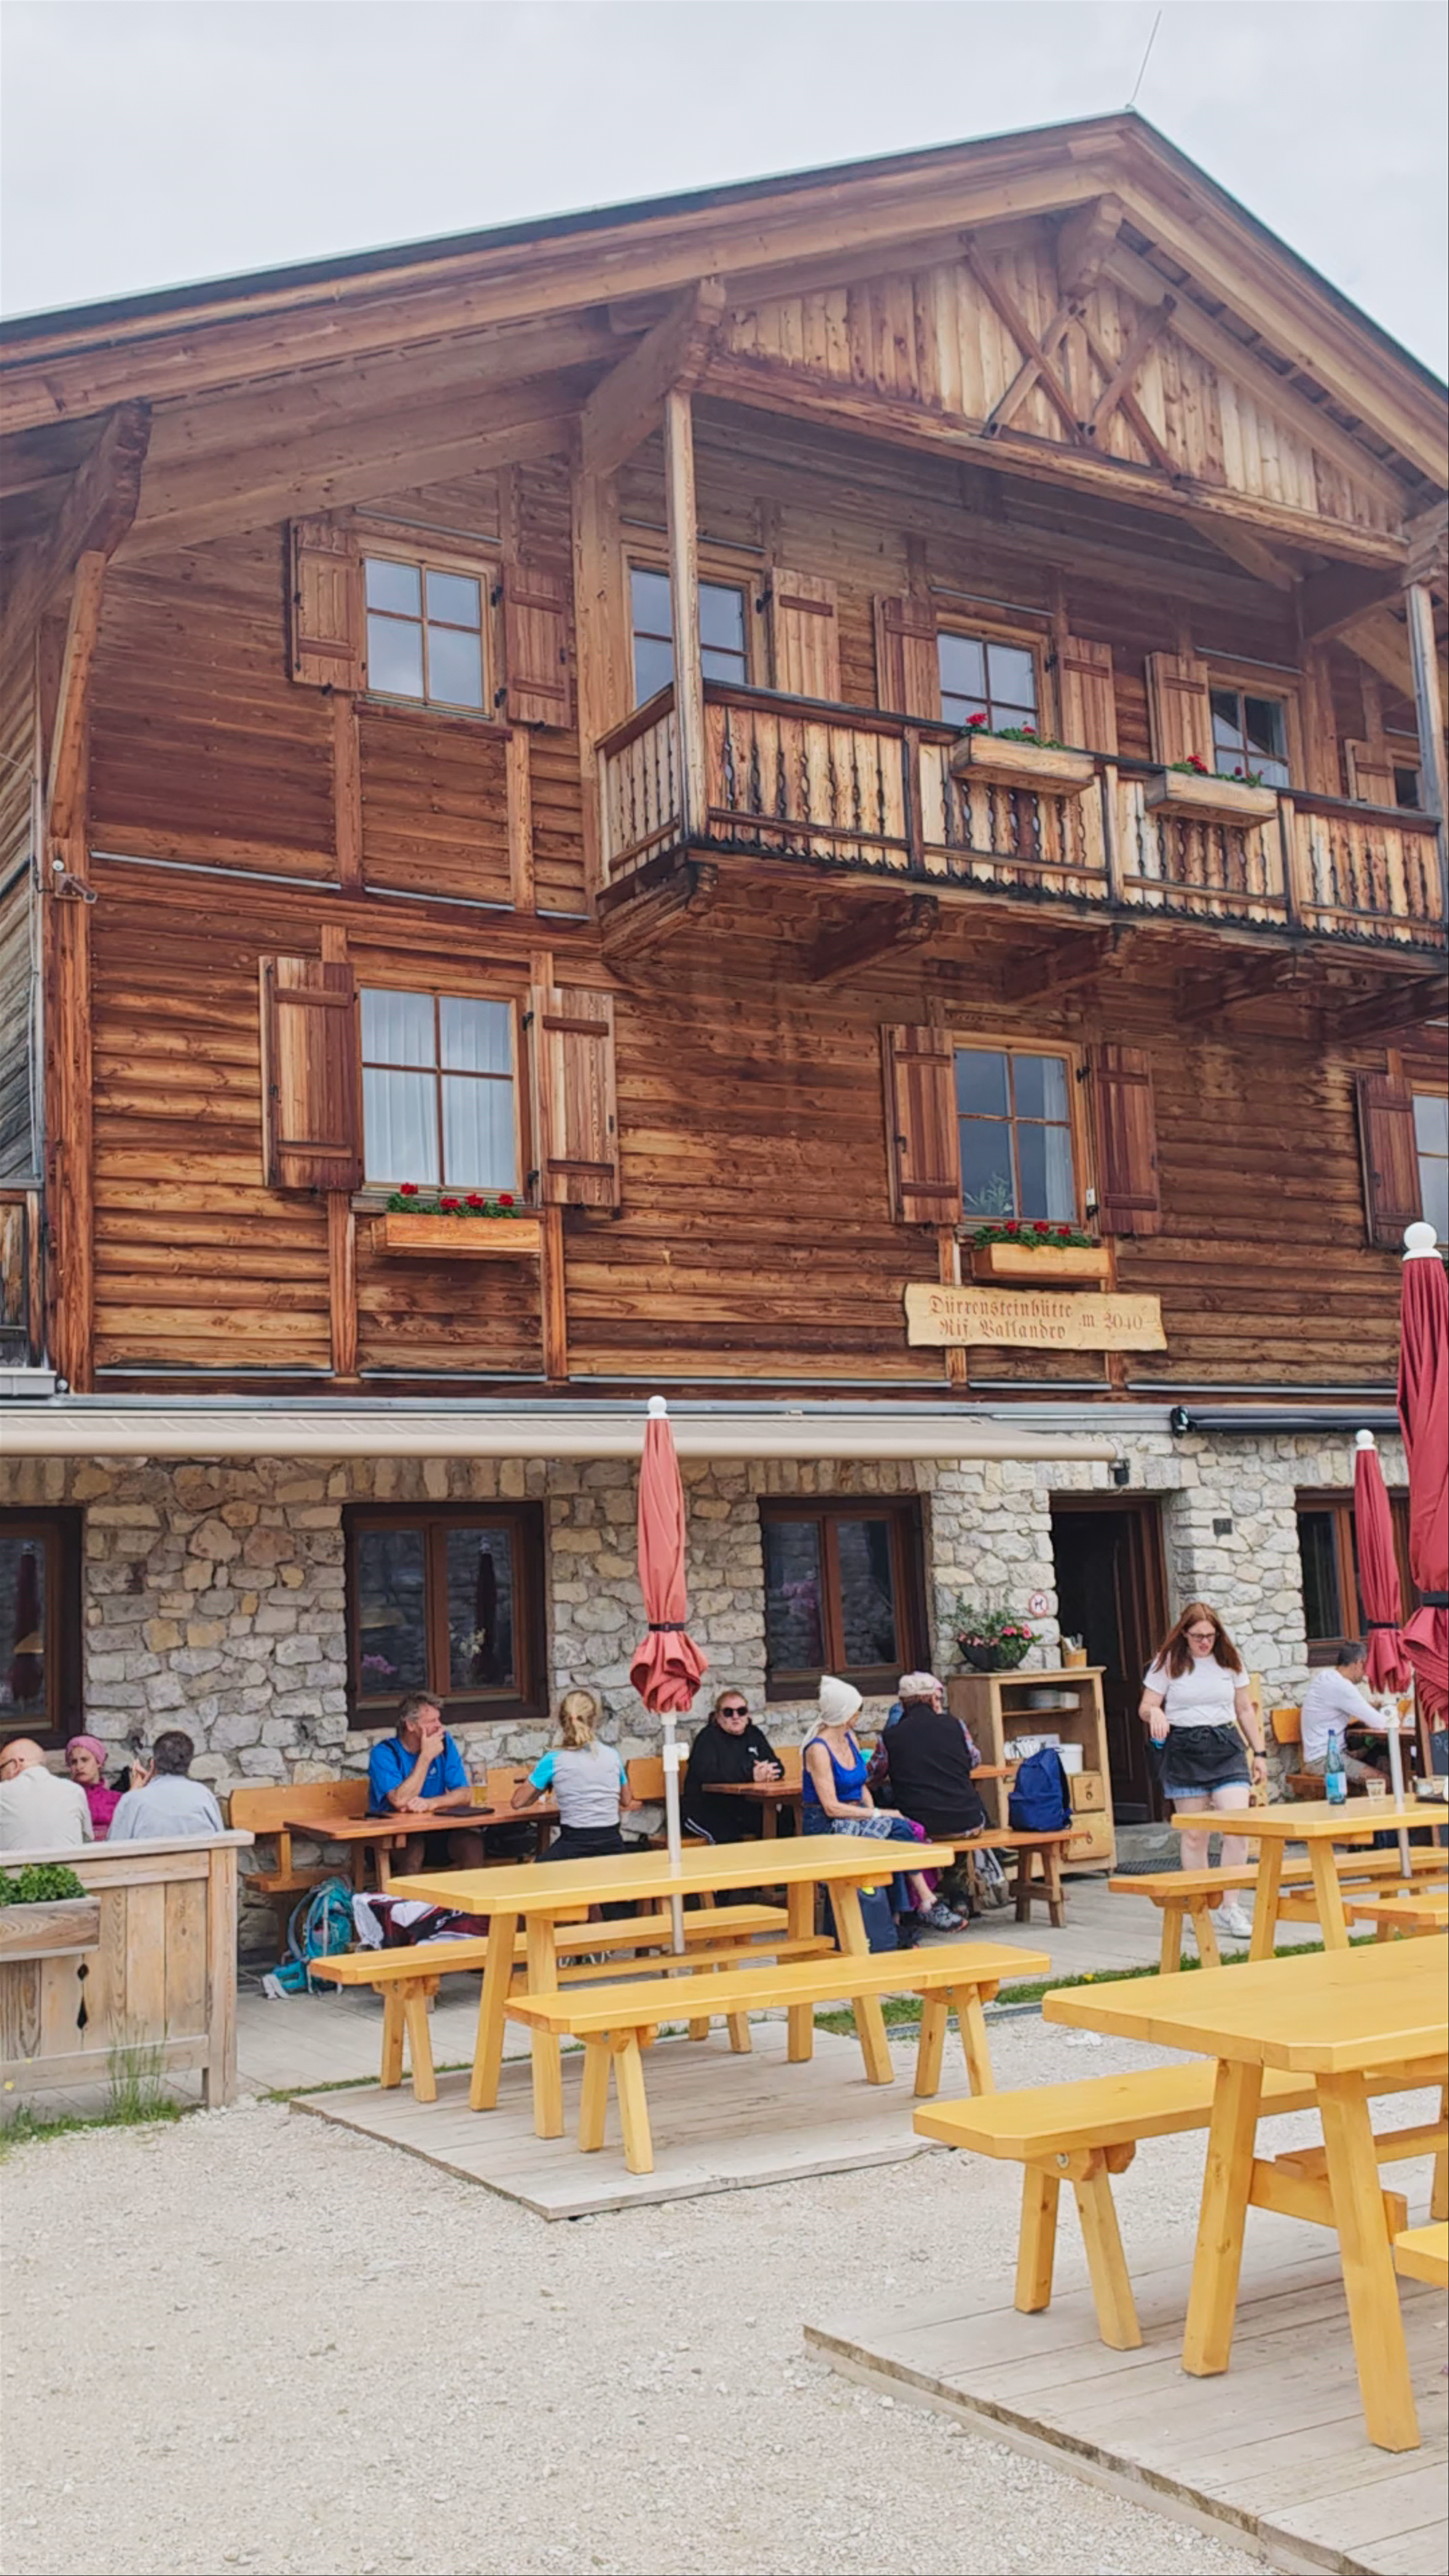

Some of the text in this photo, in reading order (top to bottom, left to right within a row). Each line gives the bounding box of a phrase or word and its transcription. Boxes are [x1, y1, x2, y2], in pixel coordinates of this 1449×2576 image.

[929, 1294, 1072, 1318] Dürrensteinhütte
[980, 1318, 1066, 1339] Vallandro
[1082, 1309, 1143, 1332] m 2040
